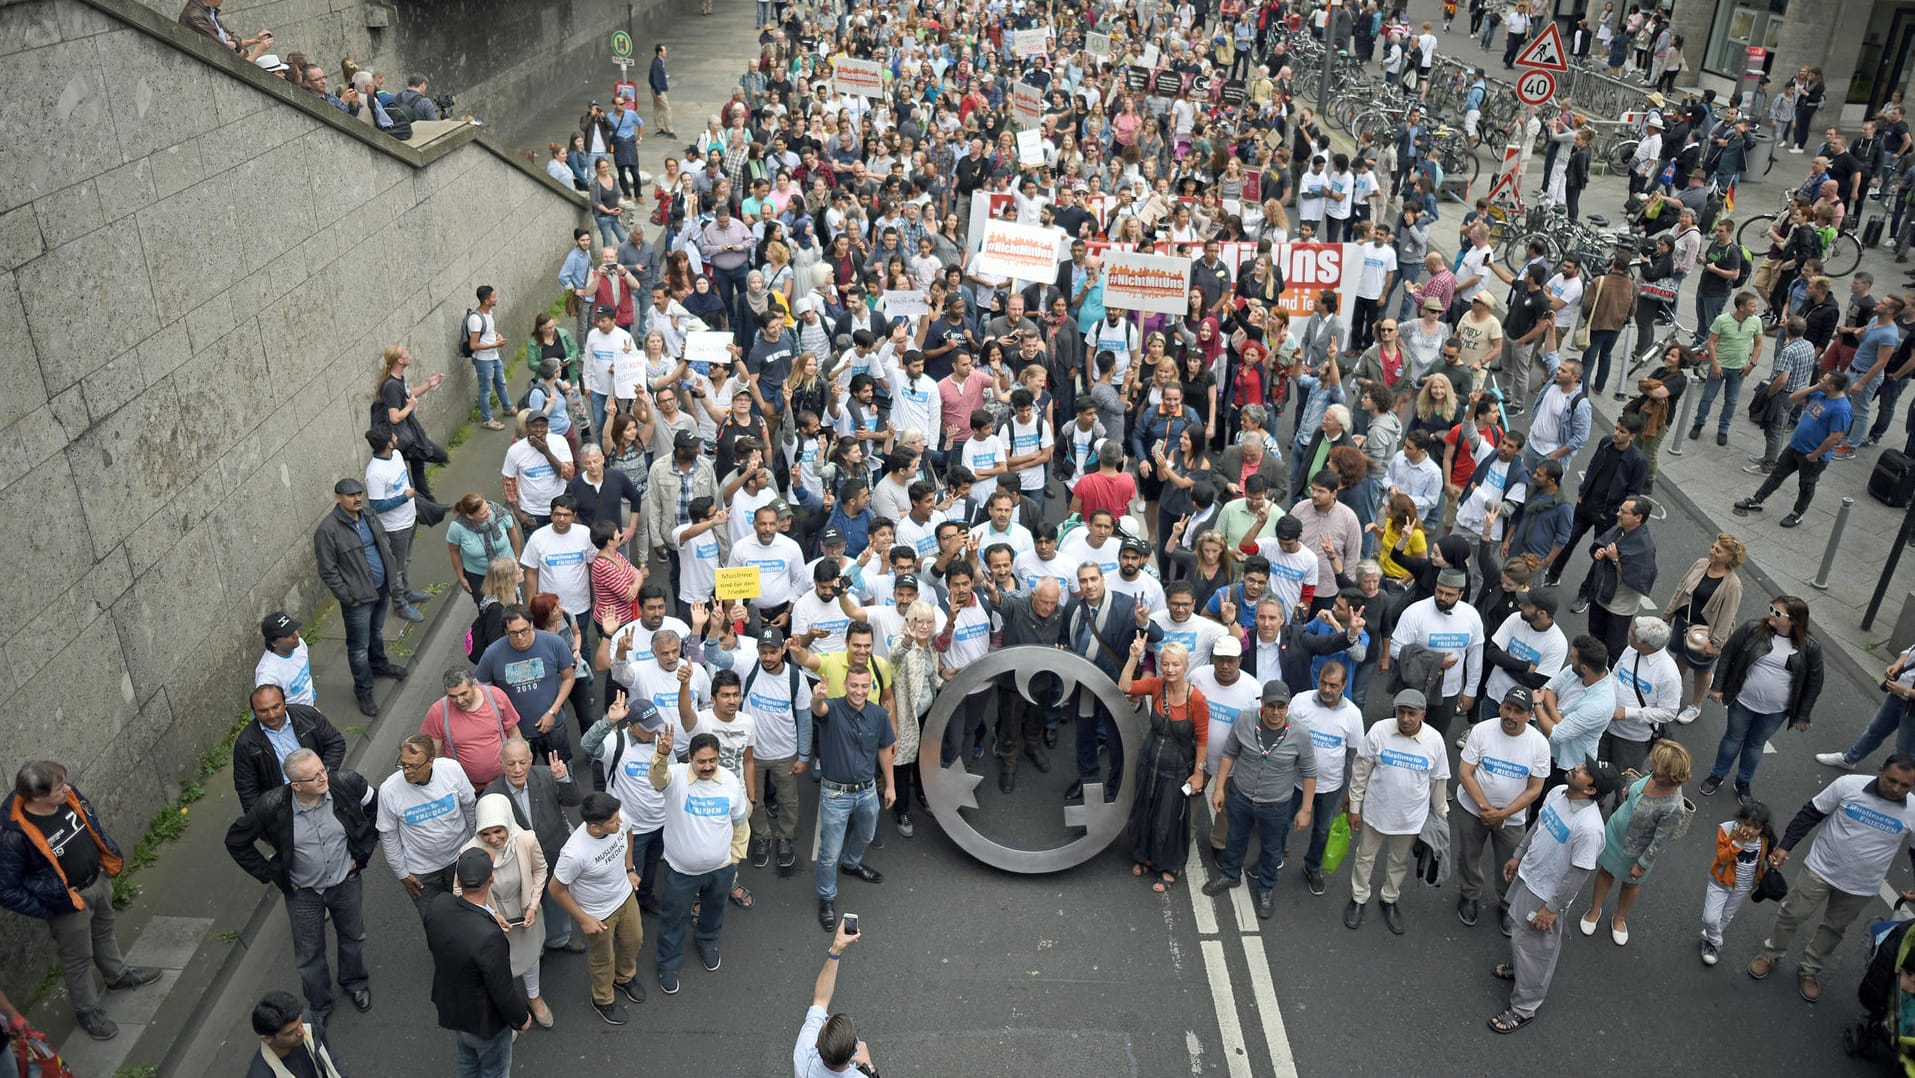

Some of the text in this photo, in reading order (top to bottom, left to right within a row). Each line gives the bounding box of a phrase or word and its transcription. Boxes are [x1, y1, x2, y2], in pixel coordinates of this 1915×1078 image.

[1524, 79, 1547, 95] 40
[987, 242, 1053, 259] #NichtMitUns
[1109, 274, 1183, 288] #NichtMitUns
[516, 683, 537, 693] 2010
[760, 702, 786, 713] FRIEDEN
[1382, 750, 1411, 762] Muslime
[1392, 760, 1425, 770] FRIEDEN
[1483, 757, 1512, 769] Muslime
[1492, 766, 1524, 779] FRIEDEN
[406, 806, 429, 816] Muslime
[415, 807, 448, 820] FRIEDEN
[1850, 804, 1883, 821] Muslime
[1860, 816, 1897, 834] FRIEDEN
[595, 831, 625, 864] MUSLIME FÜR
[604, 844, 625, 865] FRIEDEN
